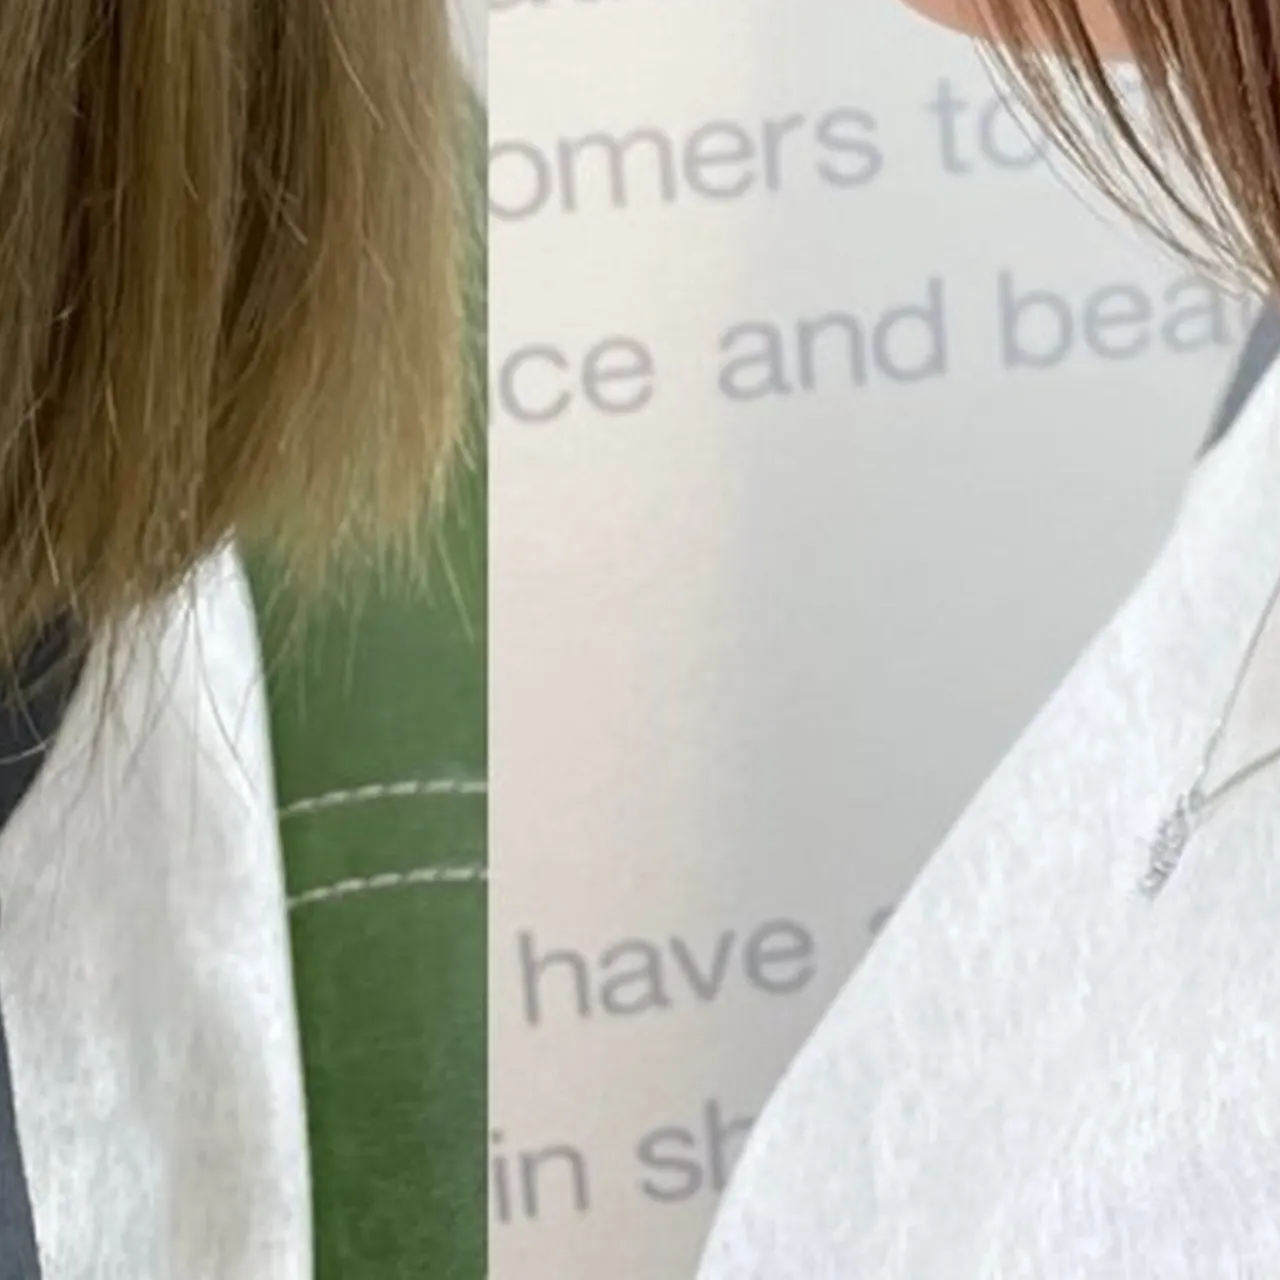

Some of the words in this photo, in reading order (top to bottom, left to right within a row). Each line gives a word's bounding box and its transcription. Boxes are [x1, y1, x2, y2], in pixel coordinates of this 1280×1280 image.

[487, 104, 884, 221] omers
[927, 77, 1052, 178] to
[488, 332, 656, 426] ce
[720, 276, 950, 402] and
[997, 268, 1252, 370] bea
[518, 916, 816, 1026] have
[491, 1130, 591, 1225] in
